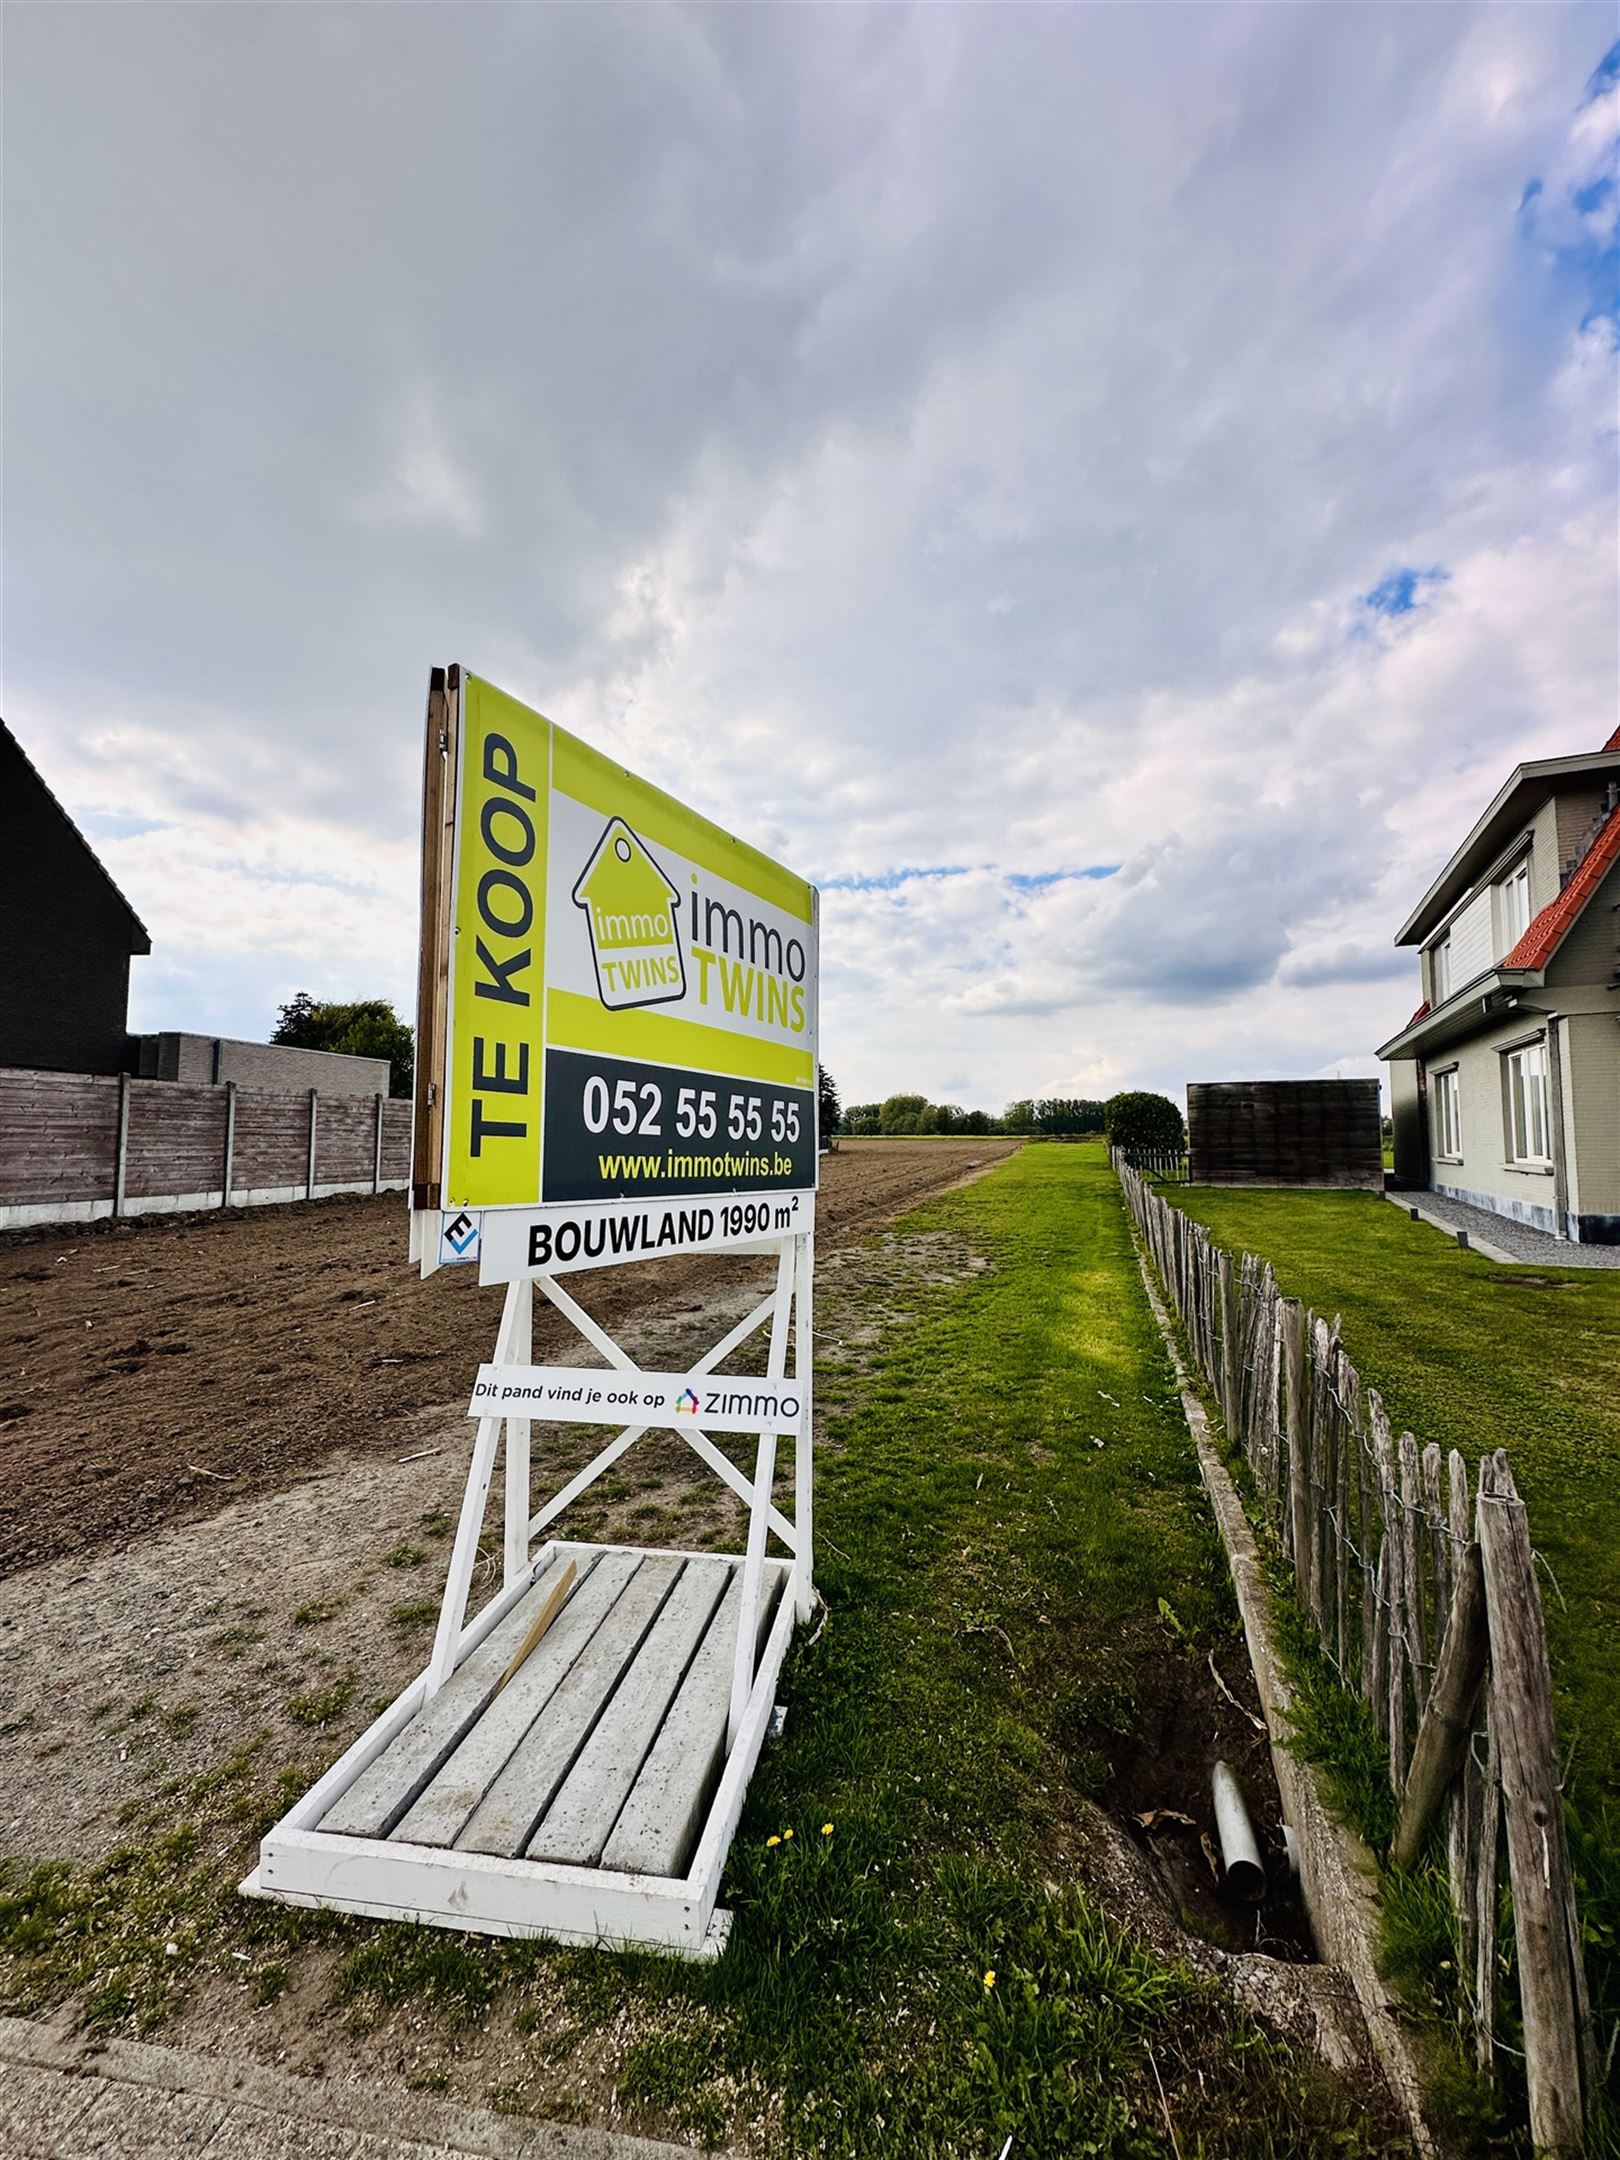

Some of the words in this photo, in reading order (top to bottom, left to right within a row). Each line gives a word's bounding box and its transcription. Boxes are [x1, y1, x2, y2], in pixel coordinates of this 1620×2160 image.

[474, 732, 536, 1007] KOOP
[597, 906, 668, 941] immo
[690, 872, 806, 983] immo
[601, 955, 680, 993] TWINS
[690, 946, 806, 1034] TWINS
[470, 1036, 530, 1158] TE
[582, 1075, 662, 1136] 052
[675, 1087, 718, 1139] 55
[727, 1094, 763, 1141] 55
[770, 1100, 800, 1143] 55
[598, 1148, 793, 1180] www.immotwins.be
[527, 1208, 715, 1267] BOUWLAND
[720, 1202, 770, 1235] 1990
[475, 1383, 498, 1397] Dit
[501, 1385, 543, 1400] pand
[548, 1386, 583, 1402] vind
[584, 1388, 601, 1405] je
[606, 1390, 639, 1405] ook
[643, 1394, 666, 1409] op
